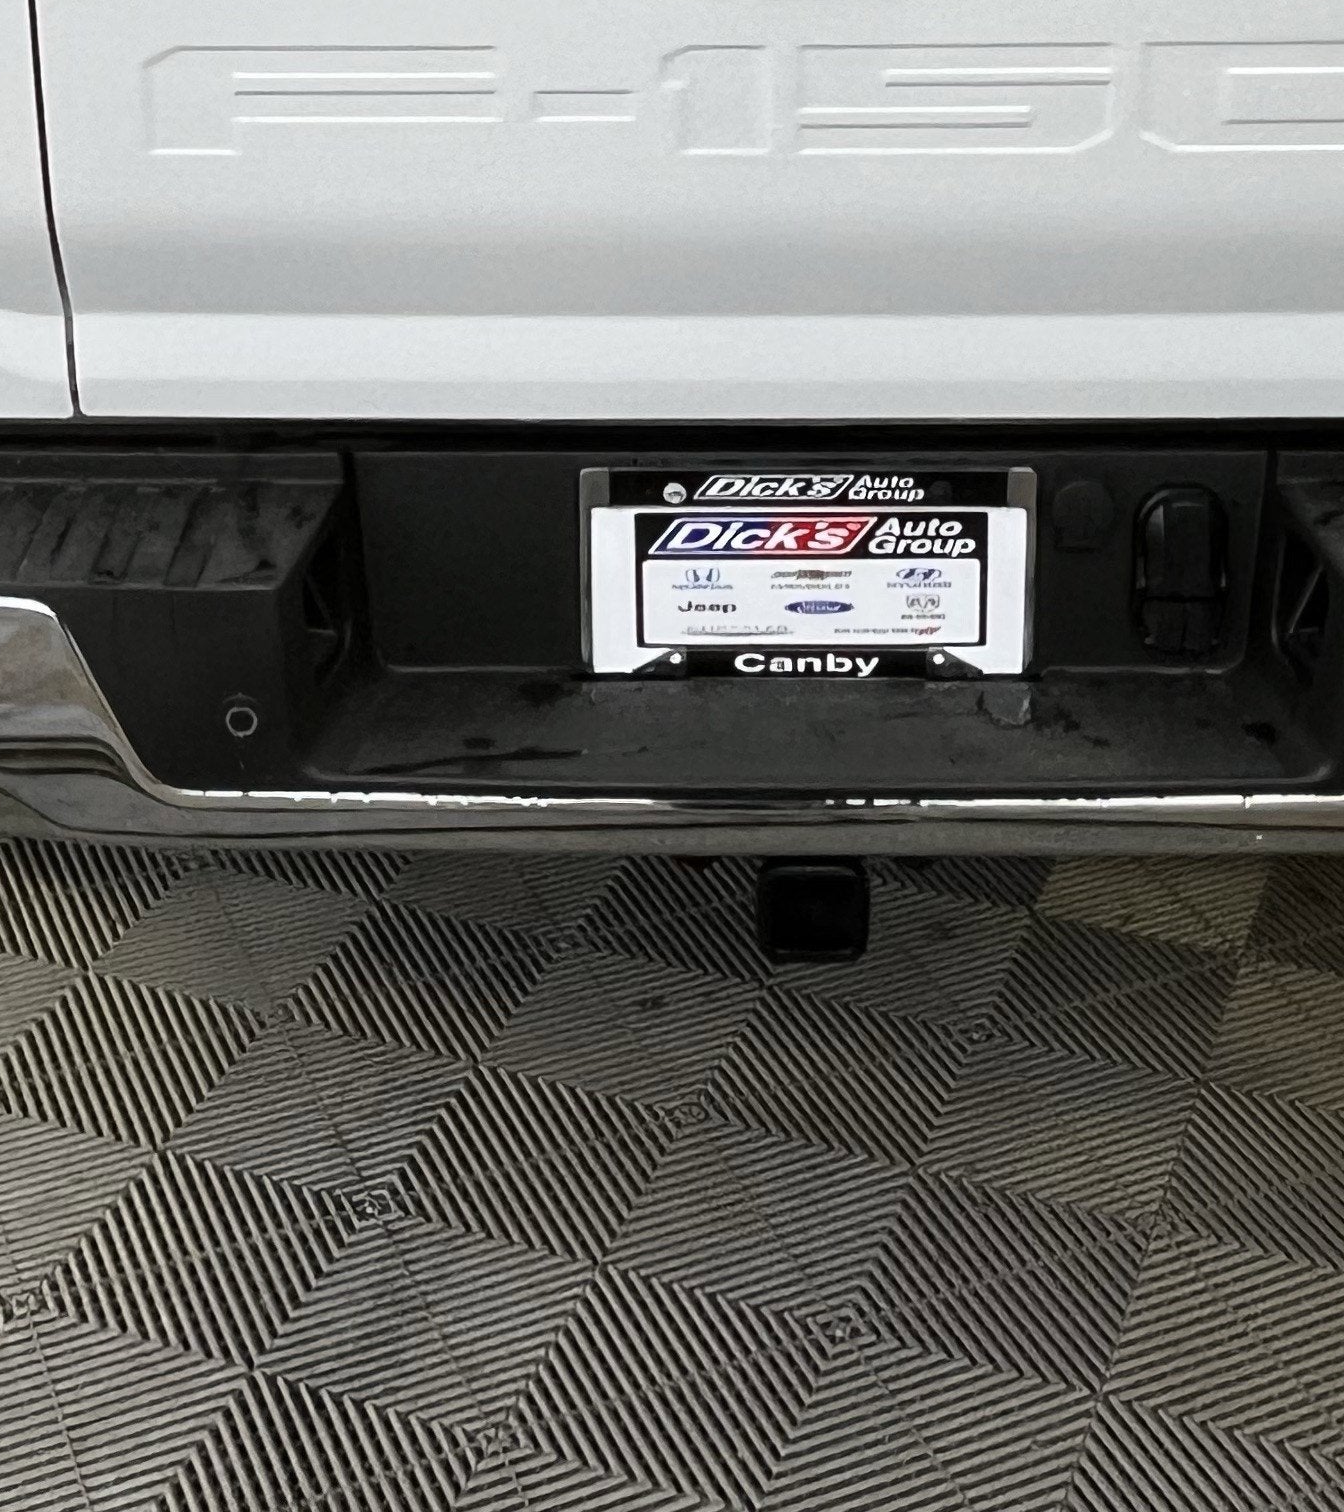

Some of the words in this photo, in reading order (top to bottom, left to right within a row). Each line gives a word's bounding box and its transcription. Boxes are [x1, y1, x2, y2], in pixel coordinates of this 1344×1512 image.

[852, 475, 914, 488] Auto
[849, 488, 925, 502] Group
[875, 517, 963, 536] Auto
[868, 535, 977, 557] Group
[733, 653, 880, 678] Canby
